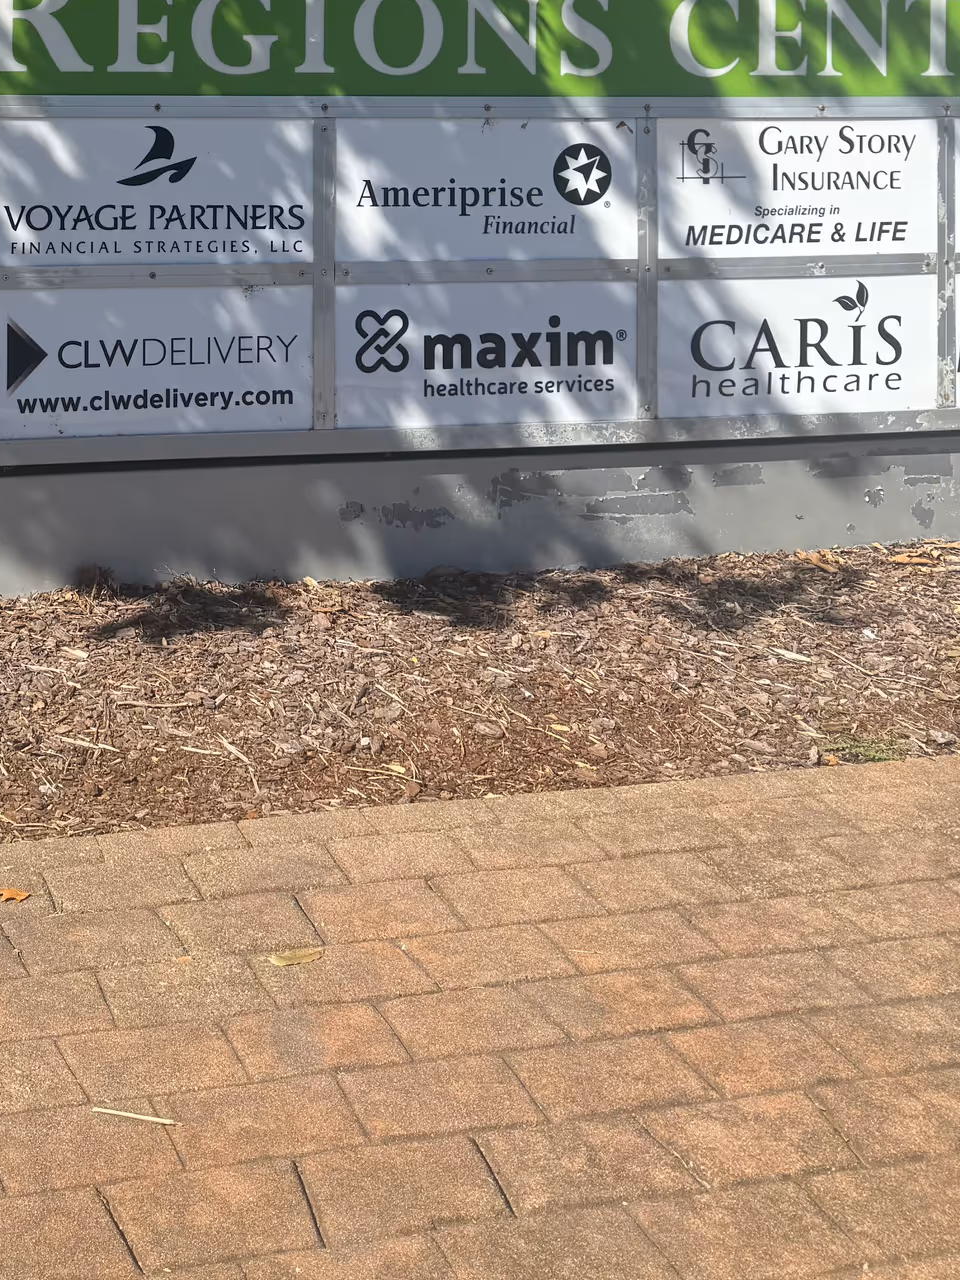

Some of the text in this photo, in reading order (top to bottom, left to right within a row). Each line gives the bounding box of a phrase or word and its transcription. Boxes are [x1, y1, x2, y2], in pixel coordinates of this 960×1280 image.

[758, 125, 917, 162] GARY STORY
[771, 163, 902, 191] INSURANCE
[356, 178, 544, 217] Ameriprise
[4, 203, 306, 232] VOYAGE PARTNERS
[482, 214, 576, 235] Financial
[754, 205, 841, 218] Specializing in
[10, 239, 305, 255] FINANCIAL STRATEGIES, LLC
[685, 221, 909, 247] MEDICARE & LIFE
[57, 334, 299, 369] CLWDELIVERY
[424, 373, 615, 398] healthcare services
[691, 370, 902, 398] healthcare
[17, 388, 295, 414] www.clwdelivery.com
